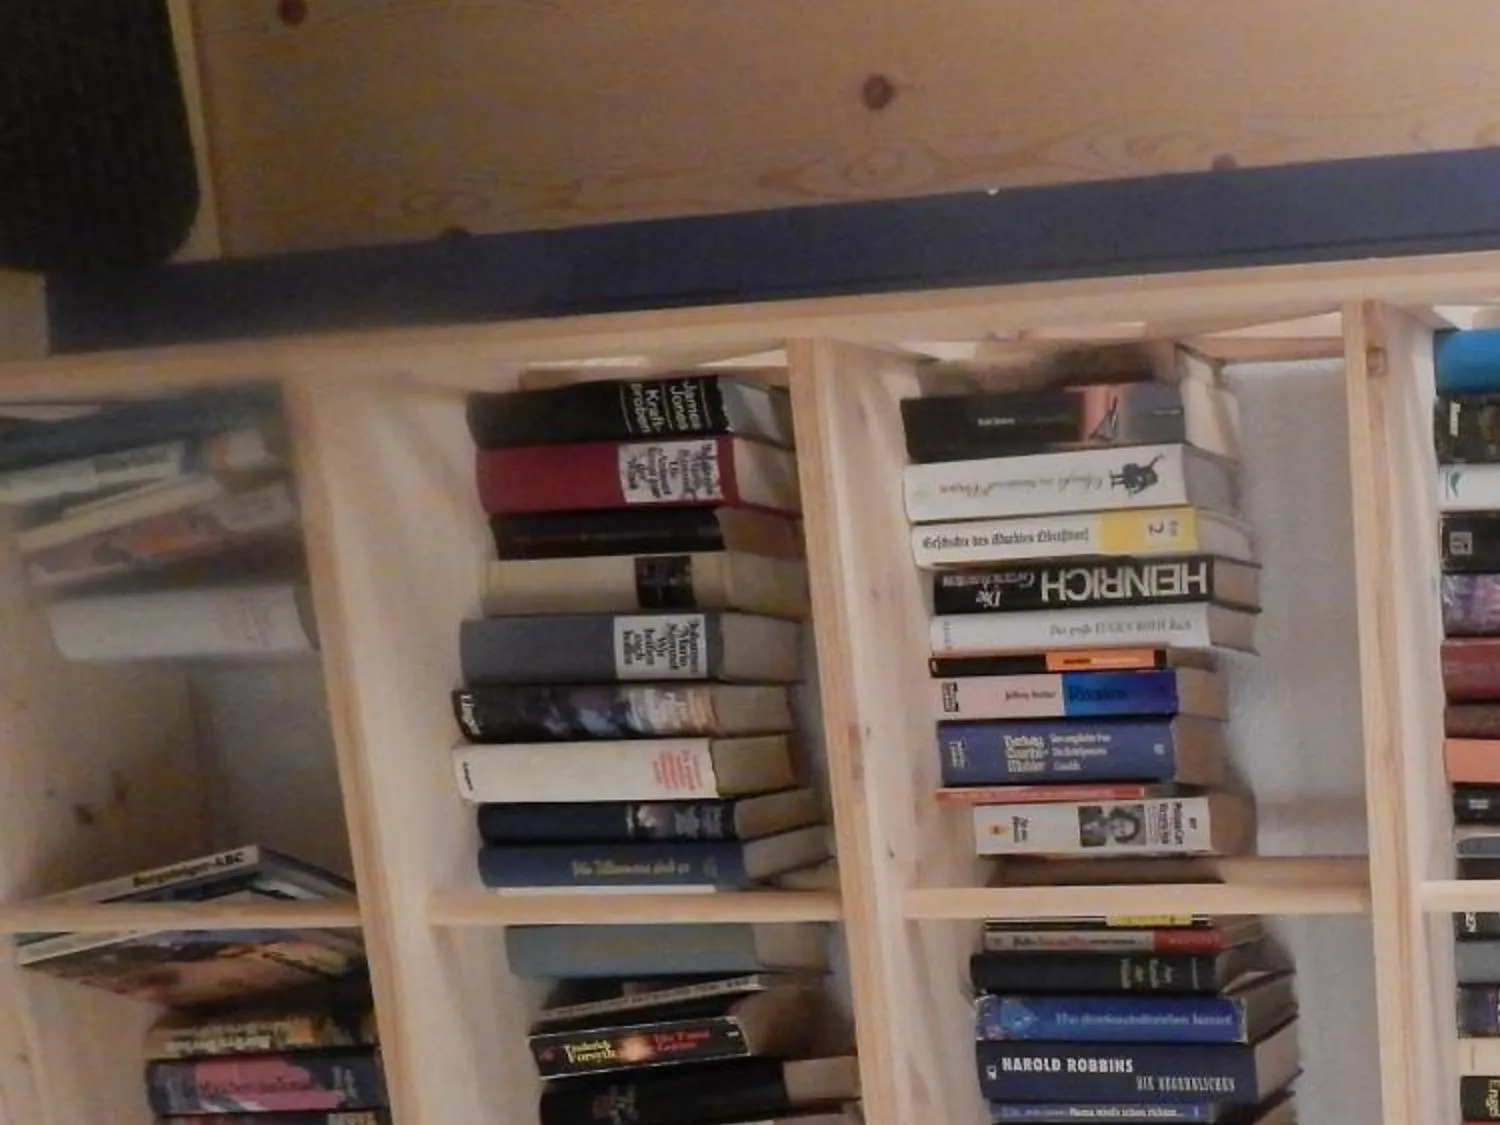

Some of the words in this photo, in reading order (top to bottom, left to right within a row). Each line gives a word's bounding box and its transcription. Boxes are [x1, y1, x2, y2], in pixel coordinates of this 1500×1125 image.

[670, 386, 687, 431] Jones
[682, 381, 699, 430] James
[1041, 561, 1208, 602] HEINRICH
[1002, 1057, 1061, 1072] HAROLD
[1067, 1057, 1134, 1074] ROBBINS
